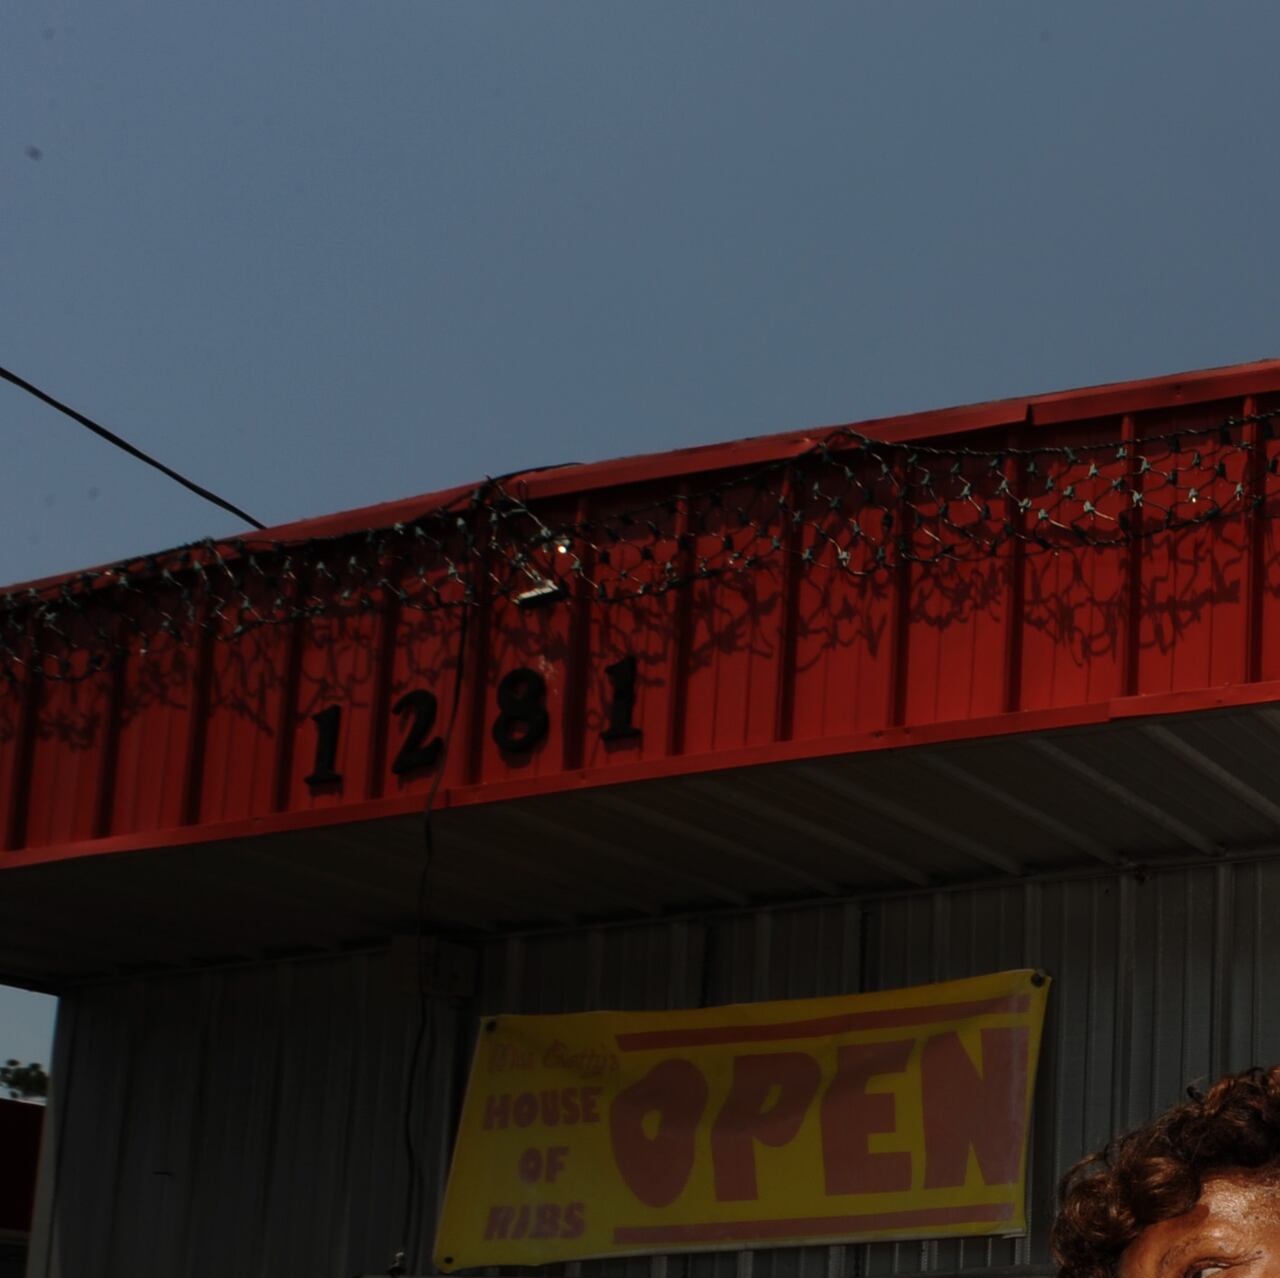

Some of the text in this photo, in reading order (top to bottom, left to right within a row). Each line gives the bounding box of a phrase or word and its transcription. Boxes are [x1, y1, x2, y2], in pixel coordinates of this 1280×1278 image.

[303, 656, 643, 786] 1281
[482, 1086, 604, 1131] HOUSE
[609, 1026, 1031, 1208] OPEN
[518, 1146, 569, 1184] OF
